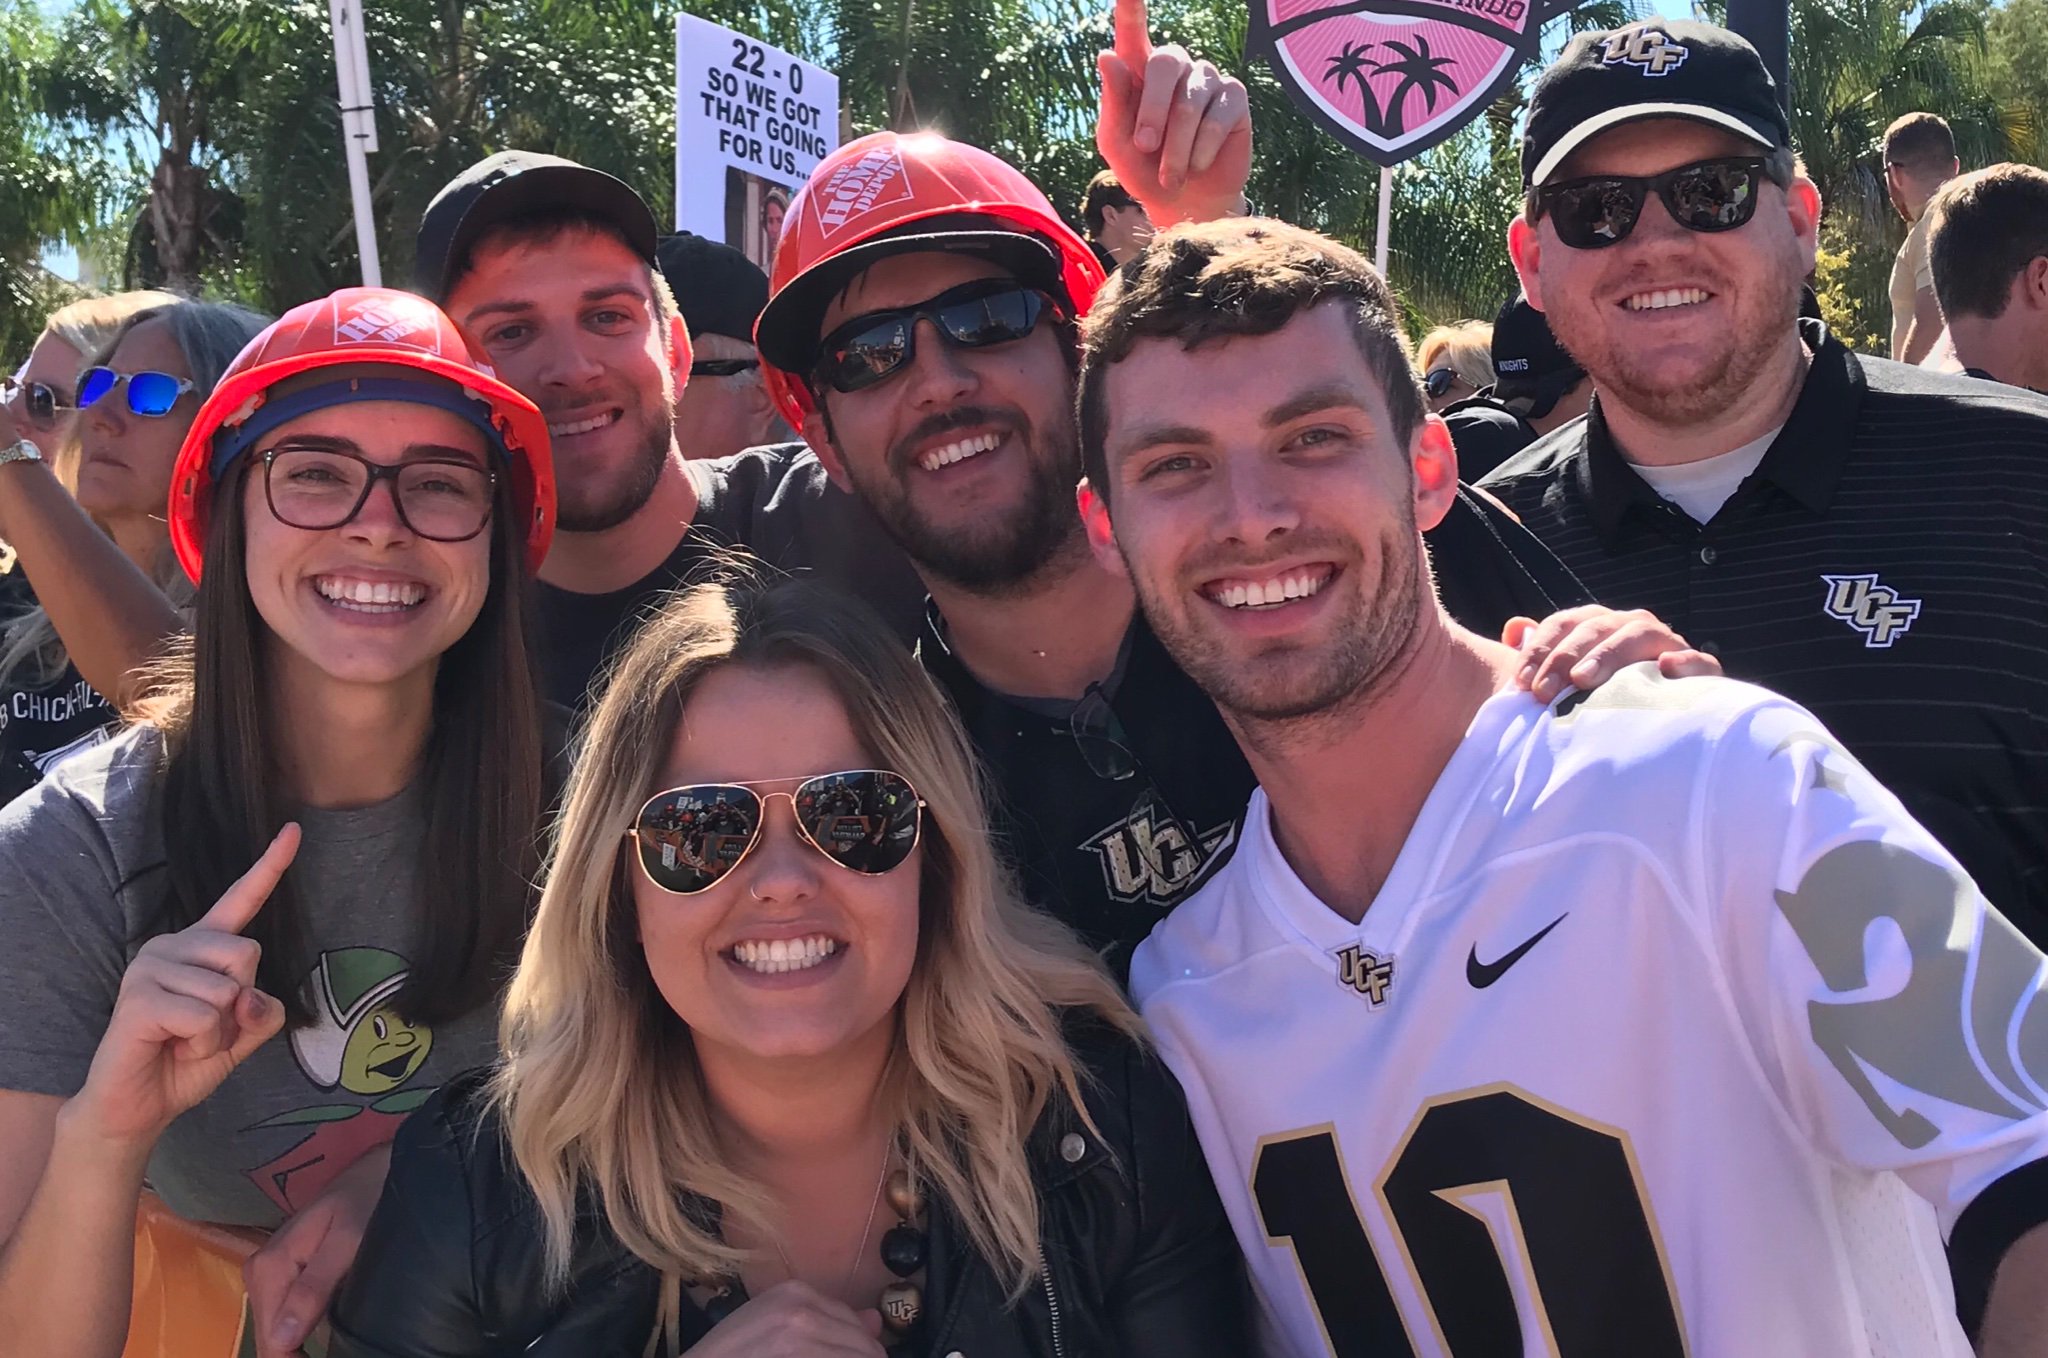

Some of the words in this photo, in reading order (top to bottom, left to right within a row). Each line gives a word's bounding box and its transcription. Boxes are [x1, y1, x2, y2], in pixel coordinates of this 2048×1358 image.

[731, 38, 765, 79] 22
[789, 63, 803, 95] 0
[1601, 25, 1687, 75] UCF
[700, 91, 760, 133] THAT
[766, 117, 827, 161] GOING
[707, 66, 739, 97] SO
[745, 79, 777, 113] WE
[783, 97, 821, 130] GOT
[719, 128, 763, 165] FOR
[821, 149, 894, 225] HOME
[823, 163, 854, 193] THE
[853, 160, 901, 211] DEPOT
[1498, 358, 1529, 371] KNIGHTS
[1820, 573, 1921, 648] UCF
[1333, 942, 1394, 1006] UCF
[1250, 1080, 1692, 1358] 10
[888, 1299, 920, 1325] UCF
